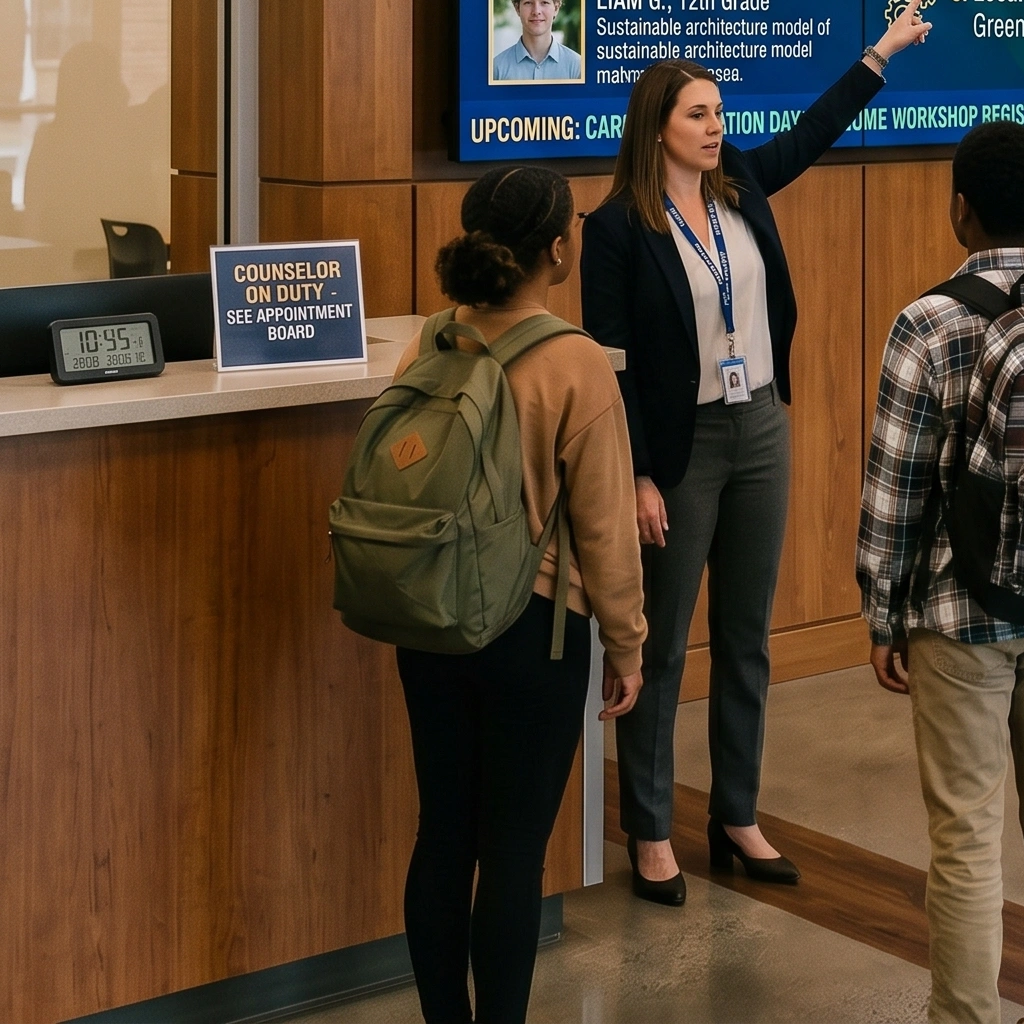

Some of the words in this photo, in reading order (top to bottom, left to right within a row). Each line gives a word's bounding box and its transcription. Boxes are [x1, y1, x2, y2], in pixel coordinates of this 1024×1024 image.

[596, 17, 681, 37] Sustainable
[685, 17, 768, 37] architecture
[772, 17, 813, 37] model
[817, 17, 831, 36] of
[596, 41, 680, 61] sustainable
[684, 41, 767, 60] architecture
[771, 40, 813, 59] model
[471, 116, 580, 143] UPCOMING:
[892, 105, 978, 129] WORKSHOP
[233, 260, 341, 283] COUNSELOR
[245, 284, 271, 304] ON
[277, 283, 324, 302] DUTY
[226, 310, 253, 326] SEE
[256, 303, 353, 323] APPOINTMENT
[267, 324, 315, 341] BOARD
